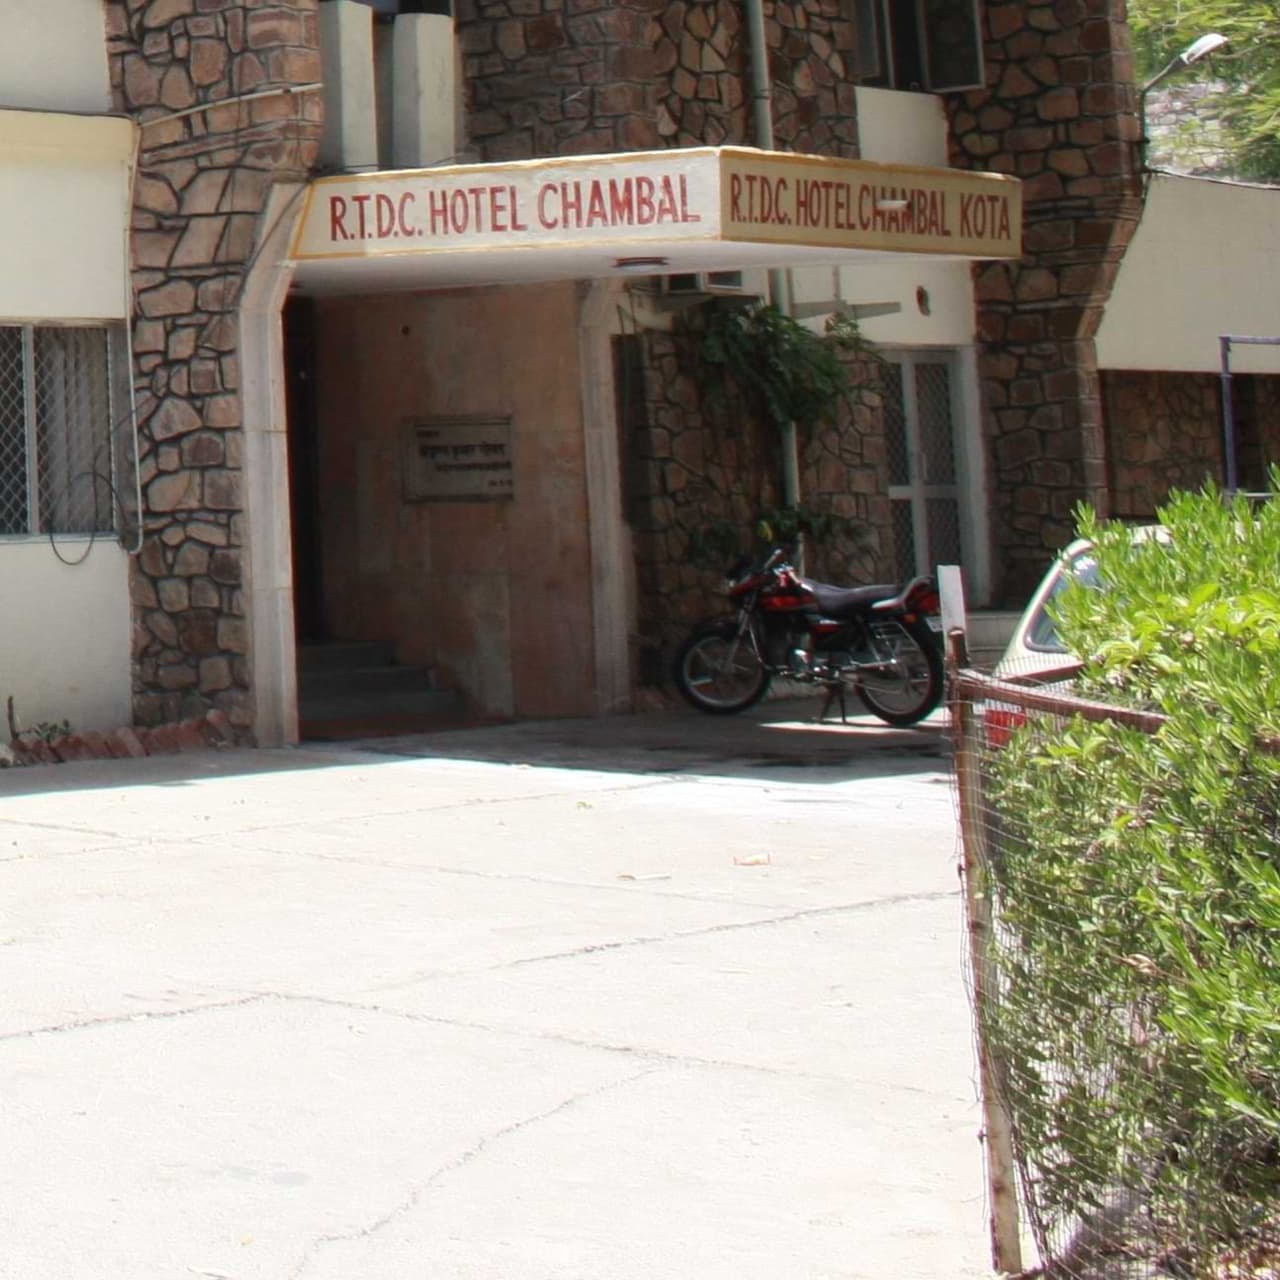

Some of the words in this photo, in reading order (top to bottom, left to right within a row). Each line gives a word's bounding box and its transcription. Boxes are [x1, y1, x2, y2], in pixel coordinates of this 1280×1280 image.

[329, 192, 424, 241] R.T.D.C.
[429, 185, 528, 233] HOTEL
[538, 173, 702, 231] CHAMBAL
[796, 179, 856, 231] HOTEL
[858, 183, 951, 238] CHAMBAL
[960, 192, 1011, 241] KOTA
